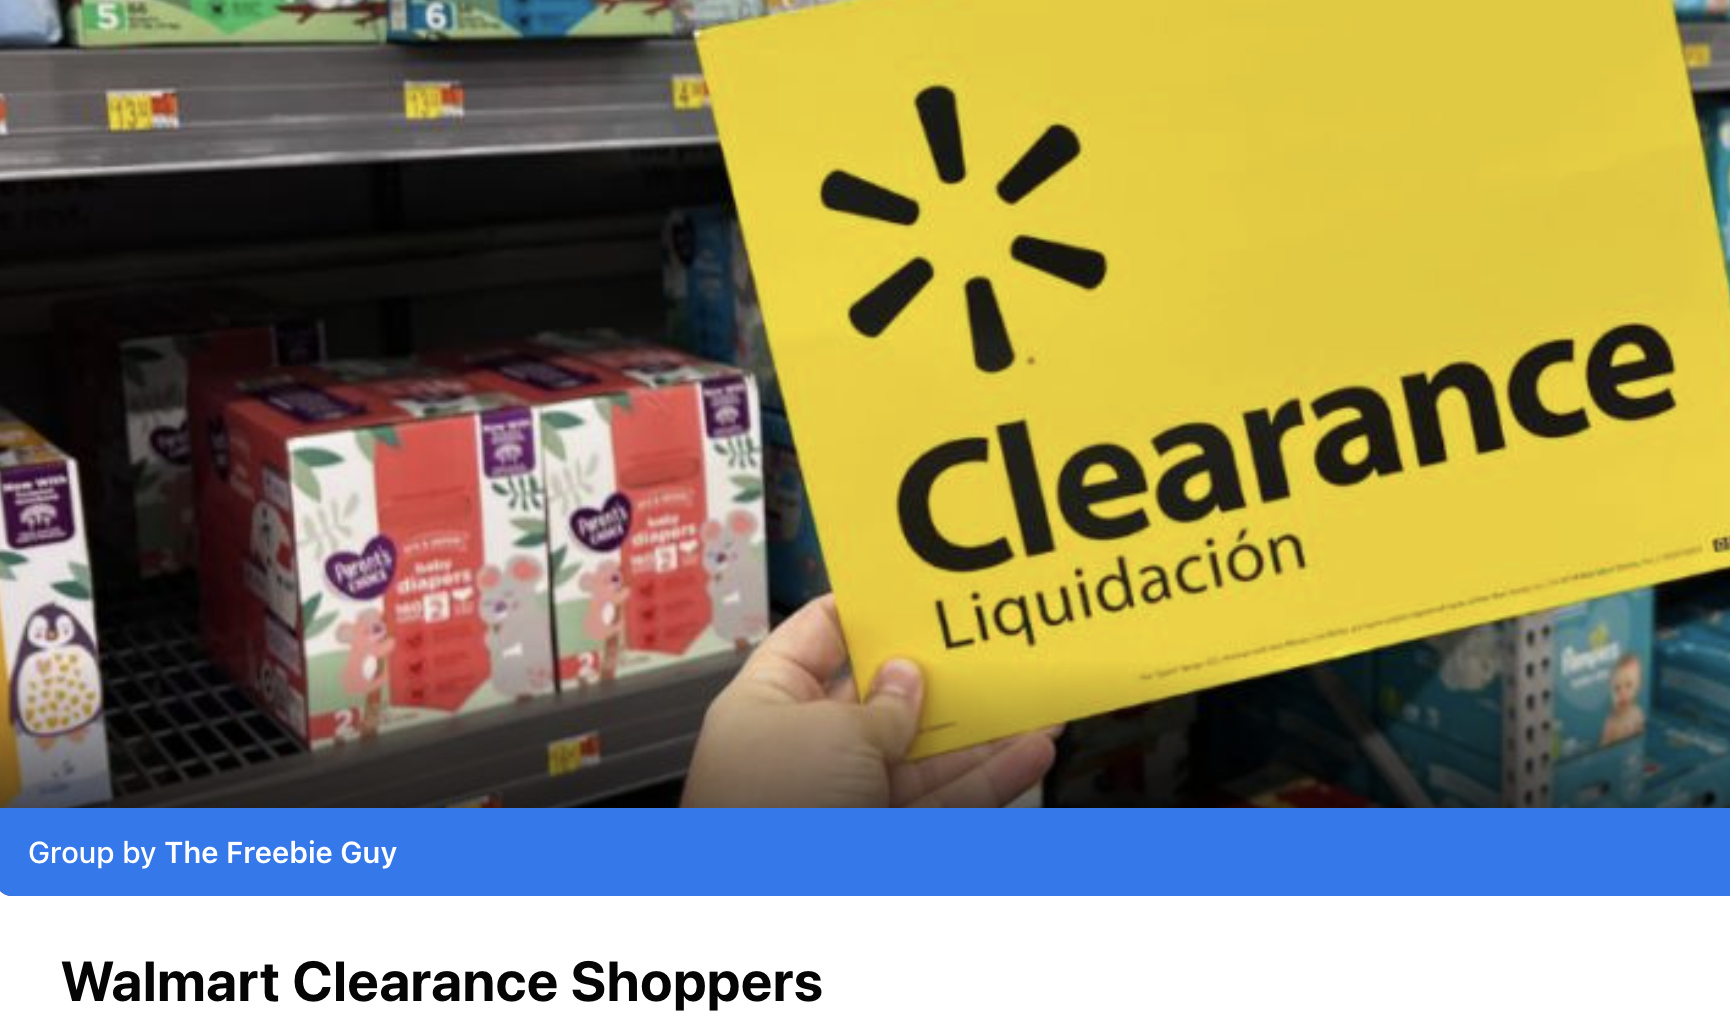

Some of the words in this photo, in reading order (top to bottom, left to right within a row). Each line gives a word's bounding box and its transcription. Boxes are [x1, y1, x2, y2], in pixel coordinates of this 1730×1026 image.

[97, 0, 120, 29] 5
[425, 1, 447, 29] 6
[897, 323, 1676, 573] Clearance
[632, 522, 698, 547] diapers
[334, 544, 392, 583] Parent's
[396, 569, 473, 595] diapers
[936, 530, 1306, 648] Liquidación
[578, 653, 598, 681] 2
[334, 711, 357, 738] 2
